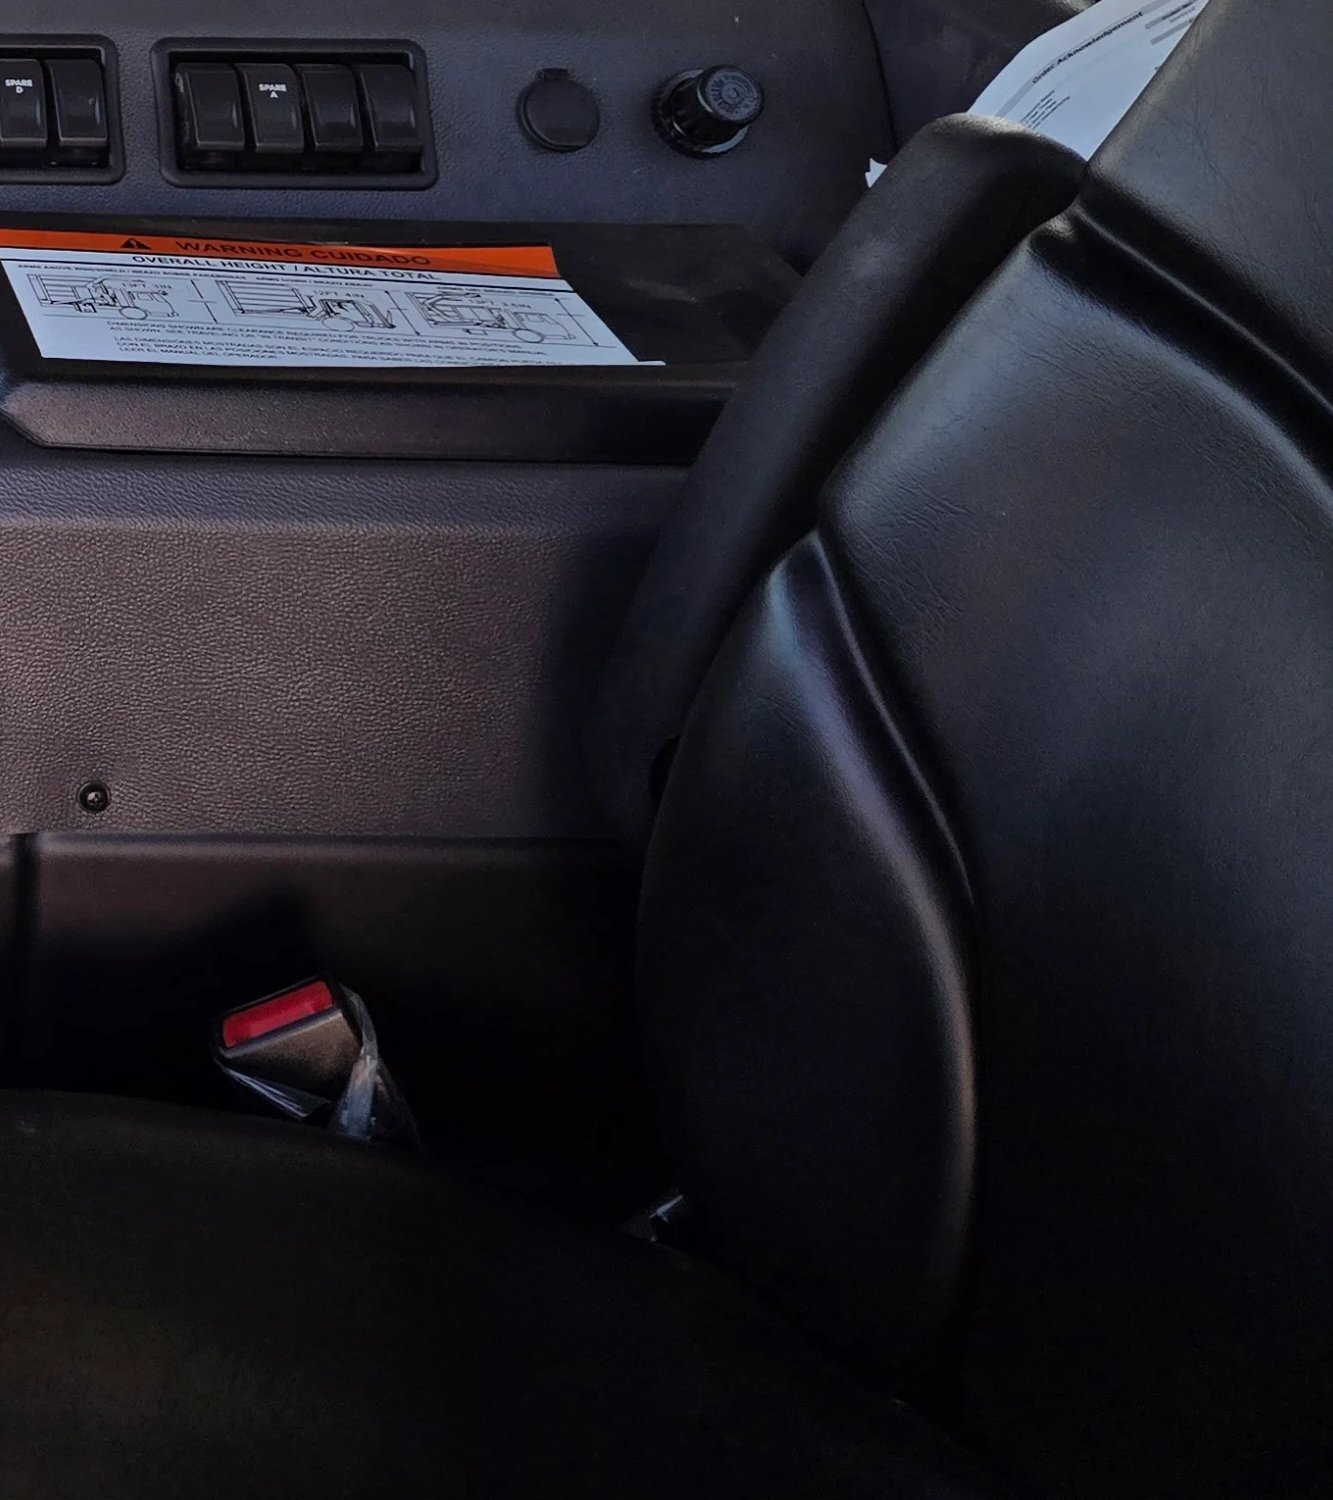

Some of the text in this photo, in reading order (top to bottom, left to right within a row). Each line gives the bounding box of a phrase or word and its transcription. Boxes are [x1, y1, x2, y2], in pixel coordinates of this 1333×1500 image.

[1032, 63, 1056, 84] Order
[1057, 11, 1143, 65] Acknowledgement
[5, 78, 33, 87] SPARE
[16, 86, 24, 94] D
[258, 84, 287, 92] SPARE
[175, 240, 431, 266] WARNING CUIDADO
[132, 256, 218, 268] OVERALL
[220, 261, 286, 271] HEIGHT
[304, 267, 376, 276] ALTURA
[381, 271, 442, 280] TOTAL
[227, 326, 284, 335] CLEARANCE
